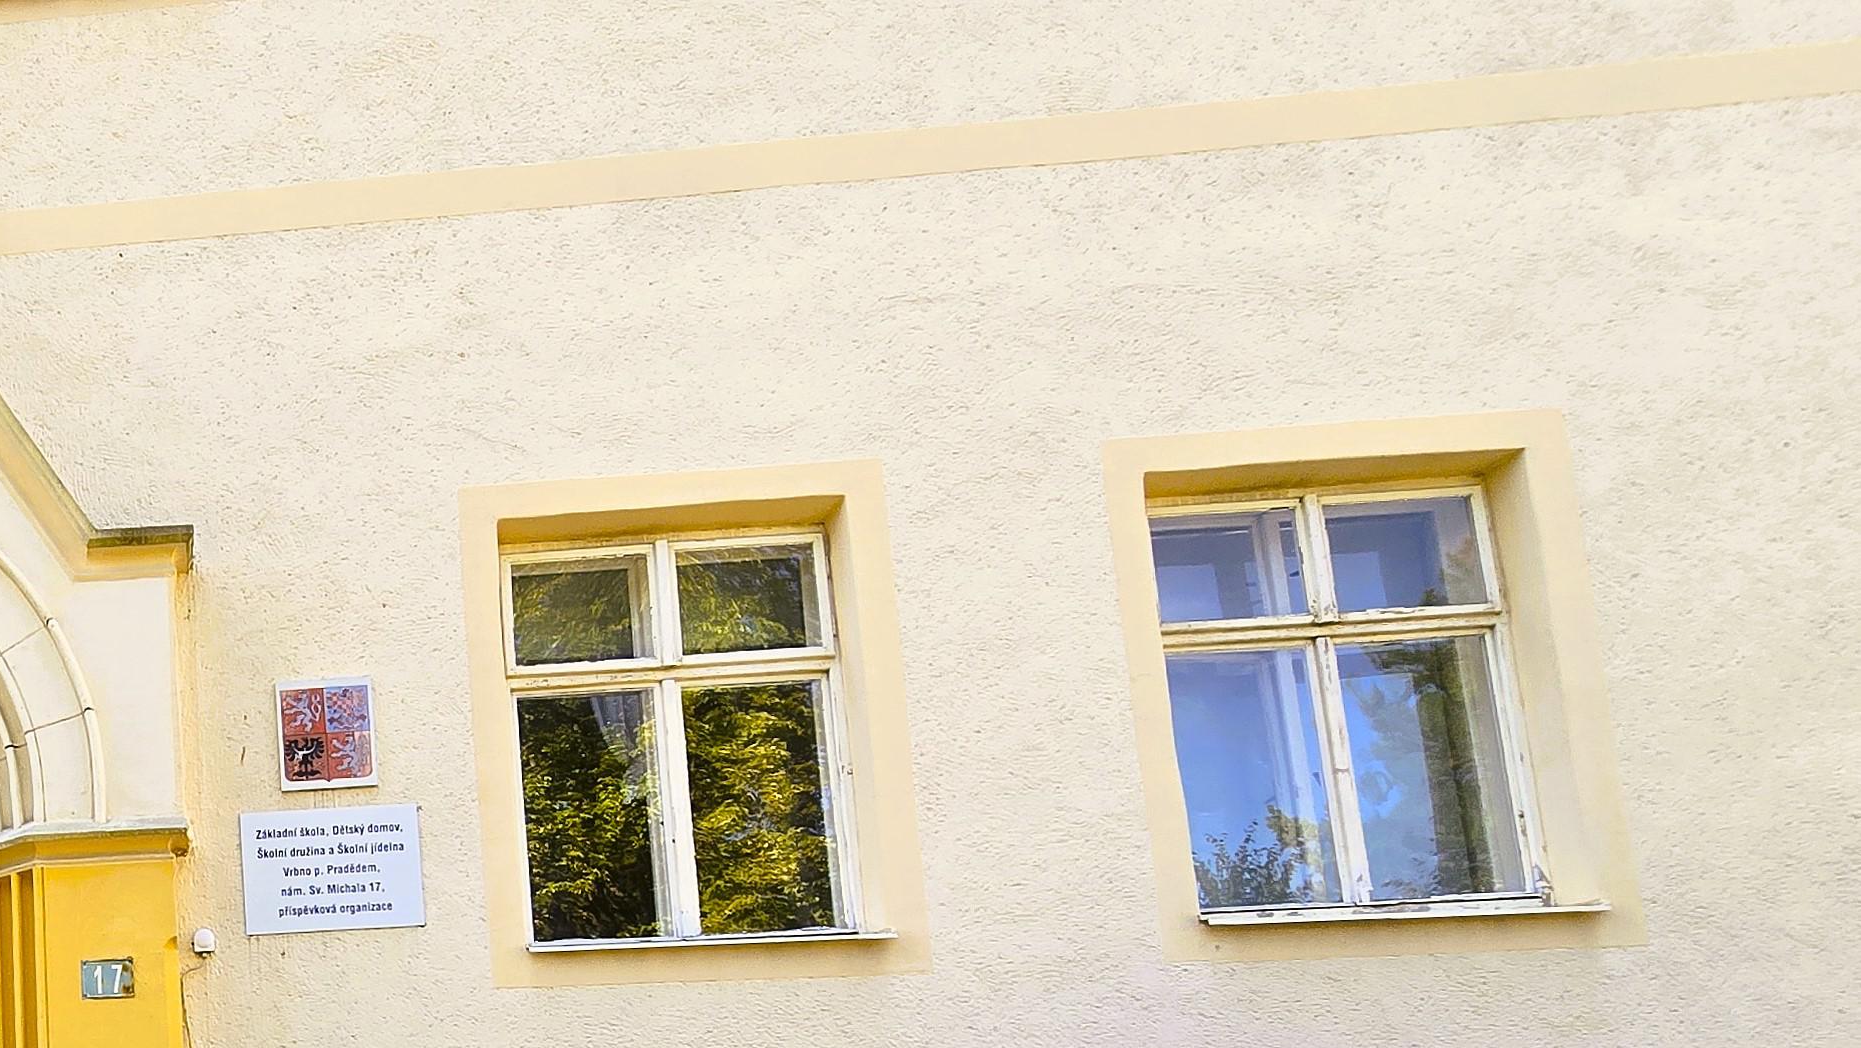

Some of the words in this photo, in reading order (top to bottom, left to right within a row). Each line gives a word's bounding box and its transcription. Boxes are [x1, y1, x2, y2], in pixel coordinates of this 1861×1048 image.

[255, 827, 297, 840] Základní
[332, 823, 365, 836] Dětský
[257, 846, 287, 859] Školní
[289, 846, 326, 858] družina
[328, 846, 335, 855] a
[337, 842, 368, 855] Školní
[370, 842, 405, 855] jídelna
[283, 866, 312, 877] Vrbno
[314, 867, 324, 877] p.
[281, 885, 306, 897] nám.
[309, 884, 324, 895] Sv.
[327, 883, 366, 894] Michala
[278, 904, 337, 918] příspěvková
[339, 902, 393, 915] organizace
[93, 964, 123, 995] 17
